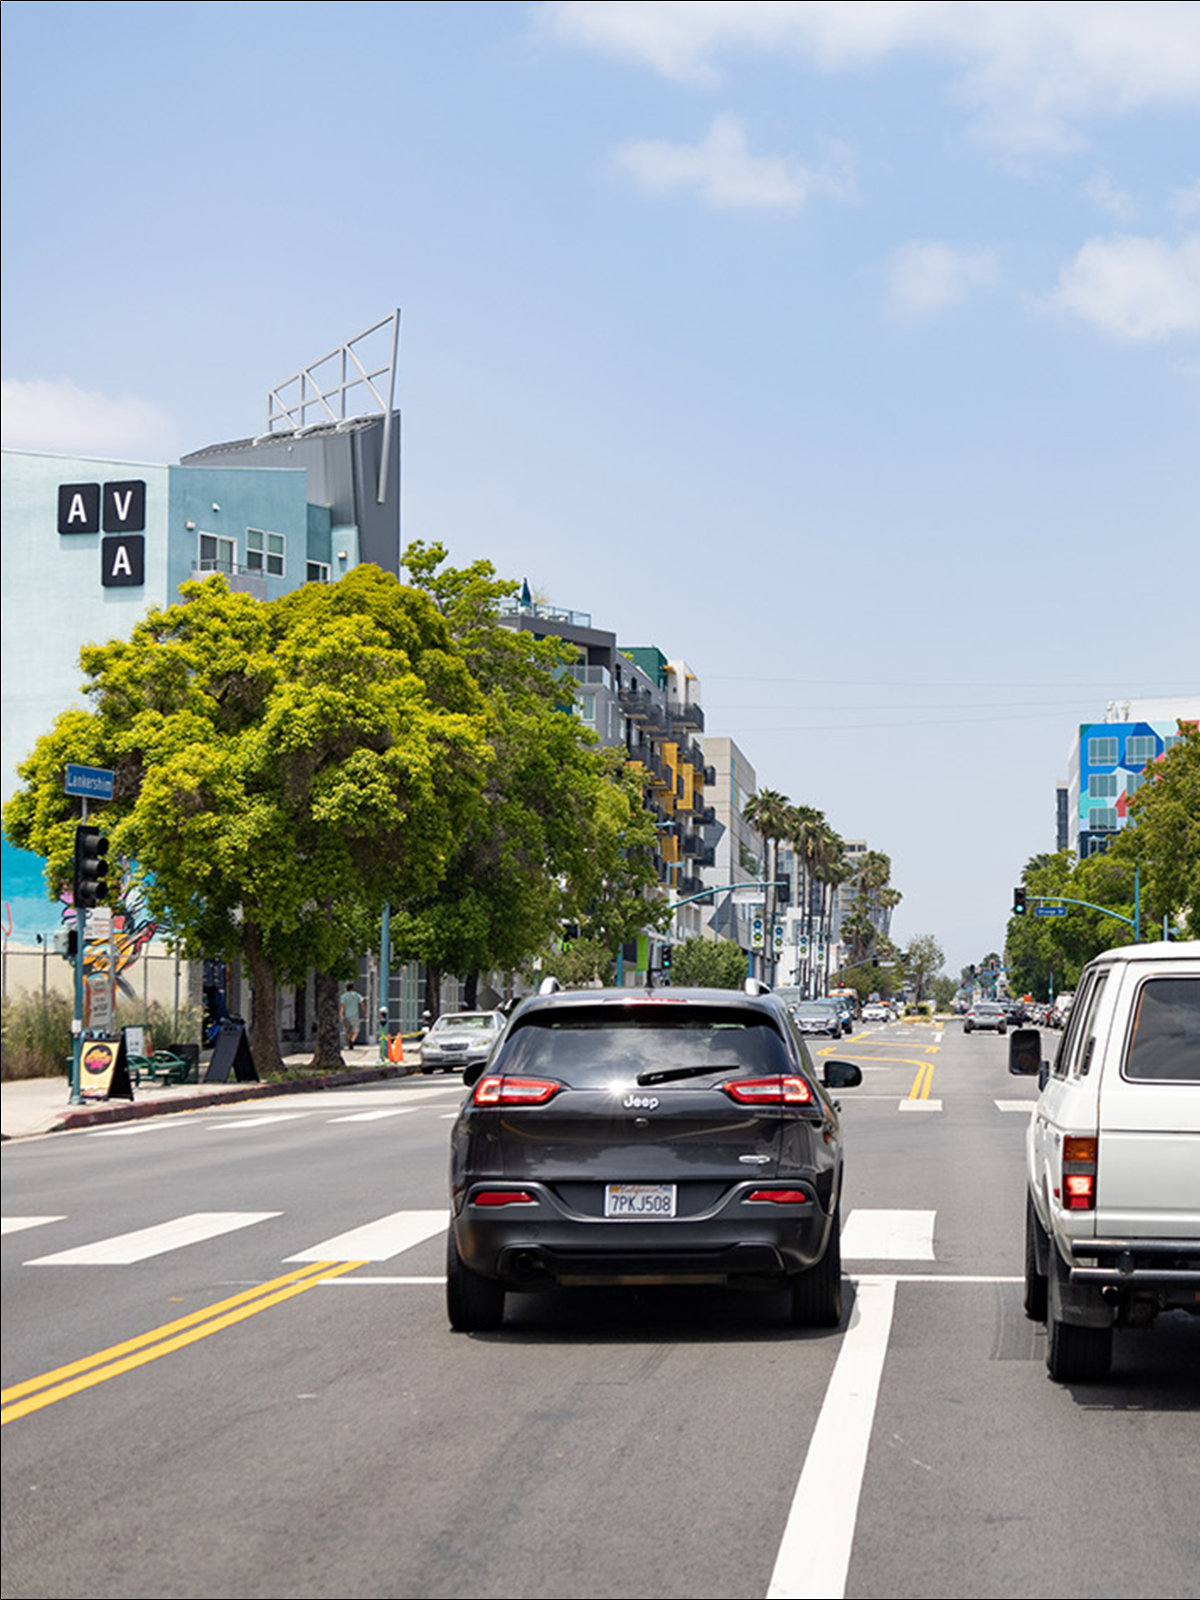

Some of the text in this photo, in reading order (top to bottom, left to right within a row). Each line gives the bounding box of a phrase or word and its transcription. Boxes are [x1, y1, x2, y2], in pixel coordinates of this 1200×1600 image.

[66, 772, 112, 792] Lankershim
[623, 1095, 659, 1110] Jeep
[611, 1195, 672, 1212] 7PKJ508
